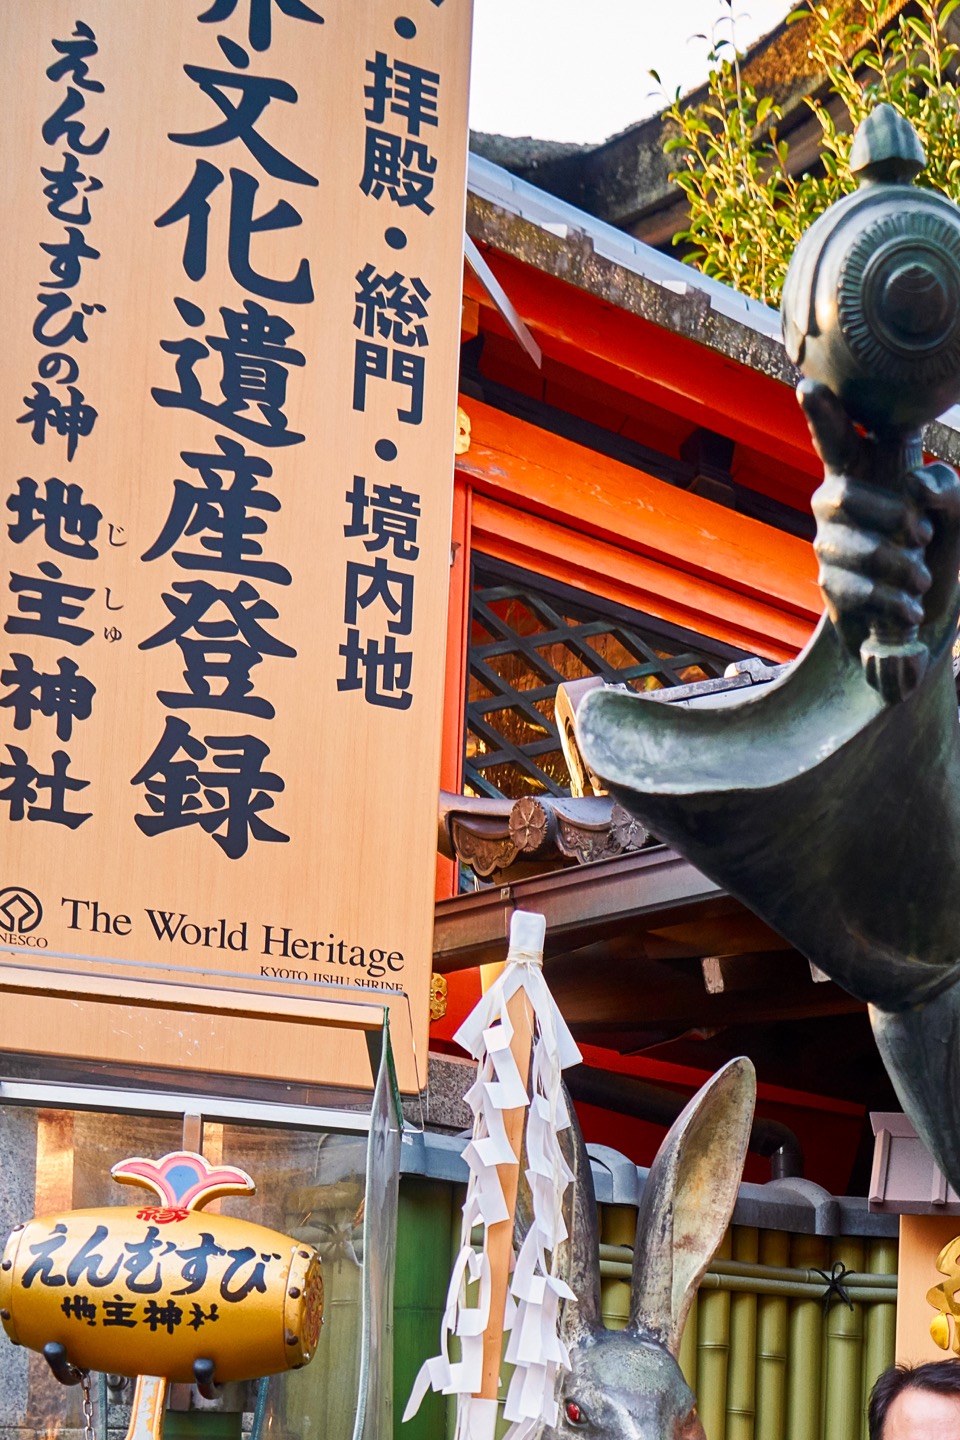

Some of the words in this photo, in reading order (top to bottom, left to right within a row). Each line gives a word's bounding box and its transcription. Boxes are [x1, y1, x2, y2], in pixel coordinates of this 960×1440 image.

[16, 20, 110, 462] えんむすびの神
[337, 0, 443, 710] ・拝殿・総門・境内地
[108, 523, 127, 547] じ
[0, 477, 103, 830] 地主神社
[62, 897, 132, 936] The
[144, 909, 248, 952] World
[261, 924, 405, 977] Heritage
[21, 1223, 281, 1303] えんむすび
[61, 1294, 219, 1336] 地主神社
